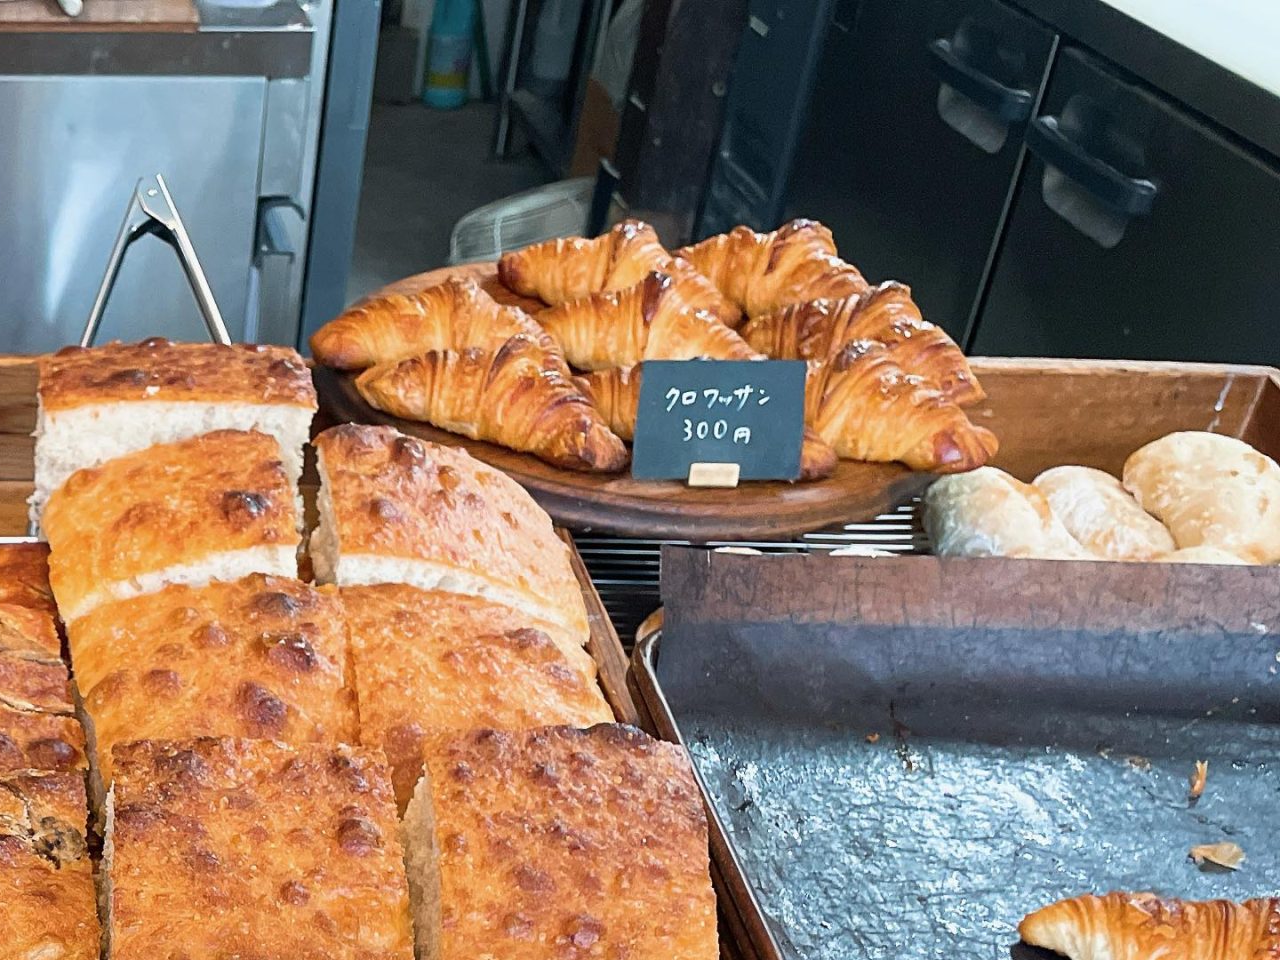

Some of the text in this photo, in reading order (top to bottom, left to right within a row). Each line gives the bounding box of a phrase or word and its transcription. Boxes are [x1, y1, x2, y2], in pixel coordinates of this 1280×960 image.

[665, 384, 770, 412] クロワッサン
[683, 419, 751, 445] 300円
